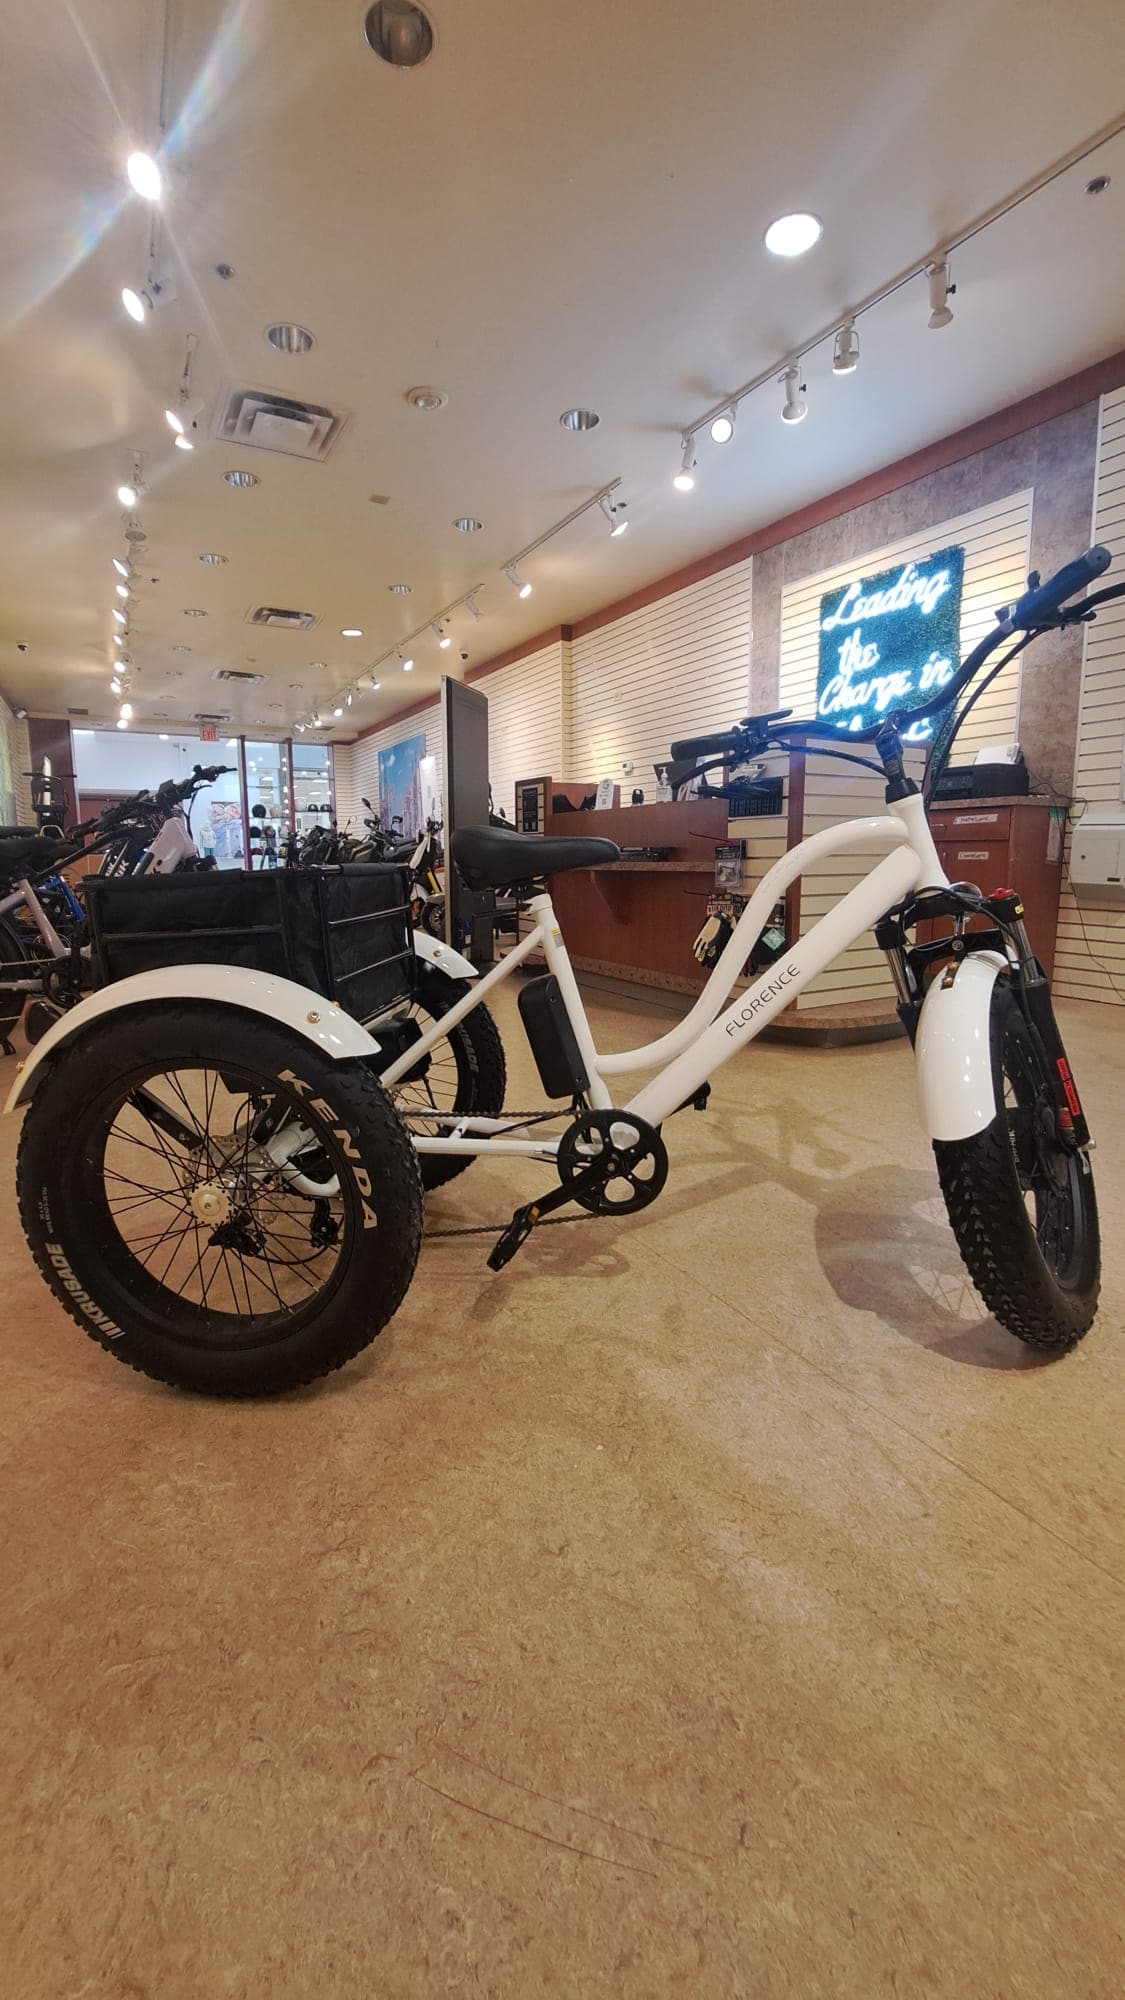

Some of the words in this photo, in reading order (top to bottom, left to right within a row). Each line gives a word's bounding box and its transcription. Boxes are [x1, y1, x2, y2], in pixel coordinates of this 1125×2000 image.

[822, 562, 952, 631] Leading
[819, 669, 912, 715] Charge
[919, 651, 953, 690] in
[838, 627, 881, 675] the
[725, 963, 801, 1037] FLORENCE
[277, 1069, 378, 1229] KENDA
[44, 1242, 111, 1326] KRUSADE
